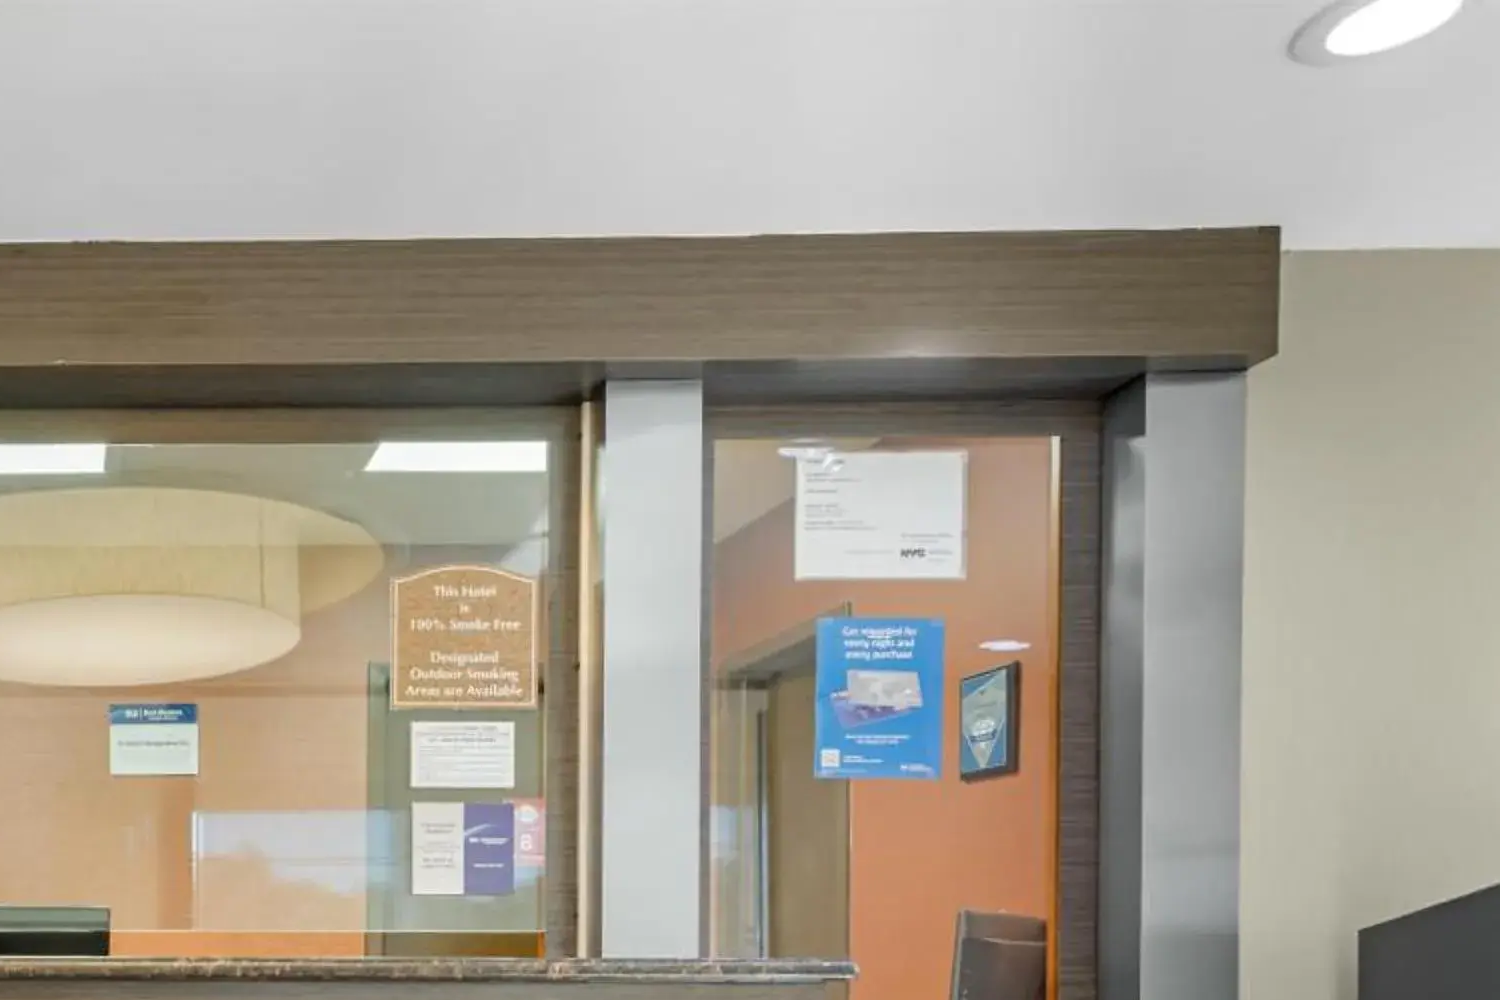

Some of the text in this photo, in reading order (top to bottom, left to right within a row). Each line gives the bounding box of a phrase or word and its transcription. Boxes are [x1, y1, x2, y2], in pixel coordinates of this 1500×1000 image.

[433, 583, 497, 598] This Hotel
[410, 617, 522, 632] 100% Smoke Free
[430, 650, 499, 667] Designated
[410, 666, 520, 682] Outdoor Smoking
[405, 683, 523, 699] Areas are Available
